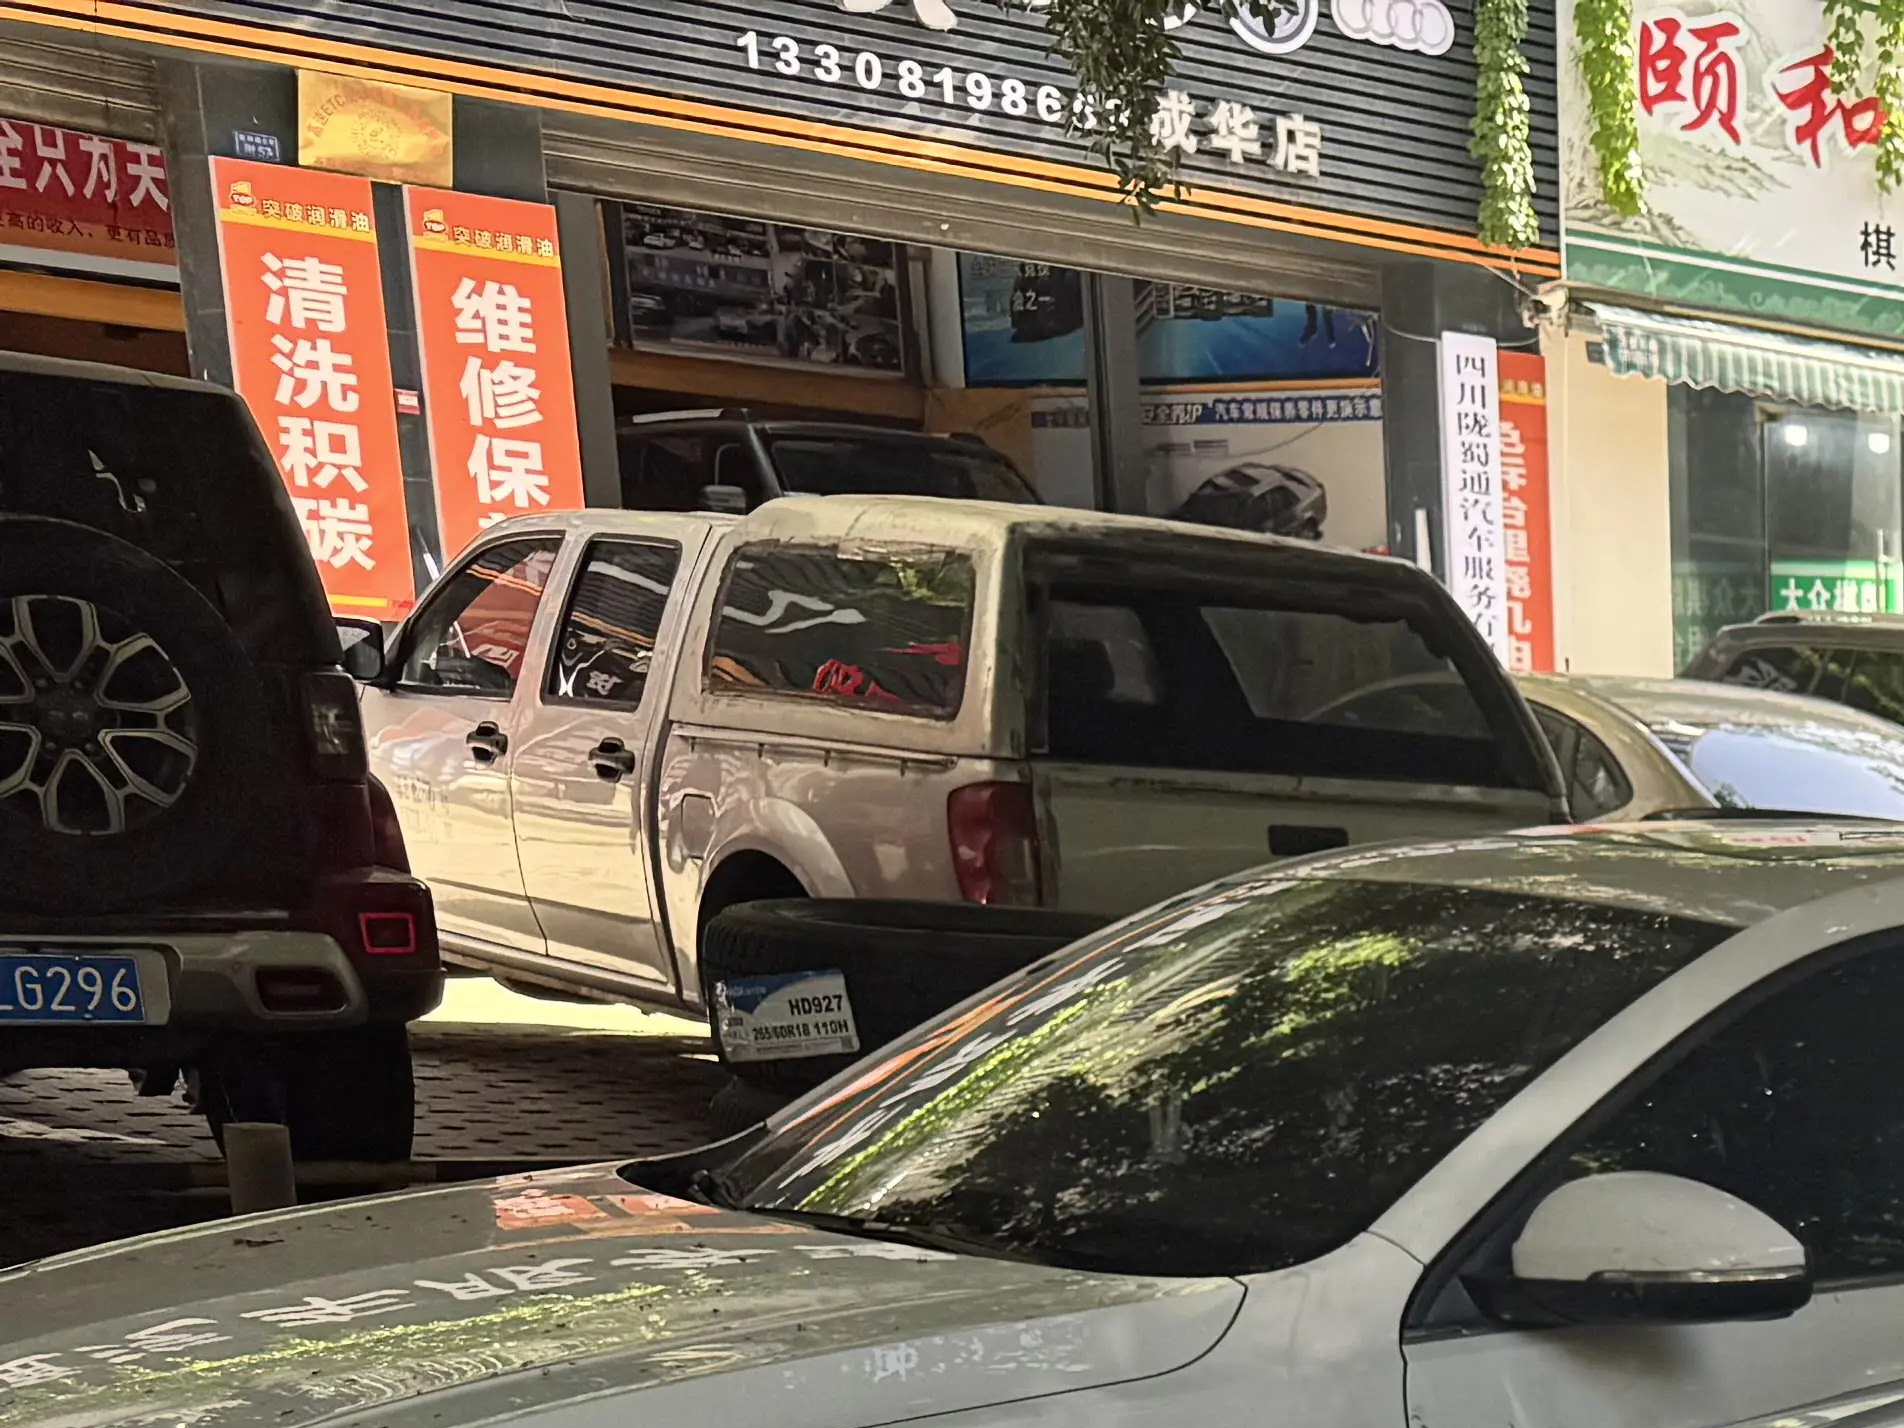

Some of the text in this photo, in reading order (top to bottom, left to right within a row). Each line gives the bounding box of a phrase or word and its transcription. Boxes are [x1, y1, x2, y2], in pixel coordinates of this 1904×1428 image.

[1149, 89, 1322, 177] 成华店
[260, 251, 376, 571] 清洗积碳
[450, 276, 551, 529] 维修保
[1454, 353, 1498, 654] 四川陇蜀通汽车服务有
[0, 966, 138, 1012] G296
[788, 995, 843, 1017] HD927
[813, 1019, 849, 1035] 110H
